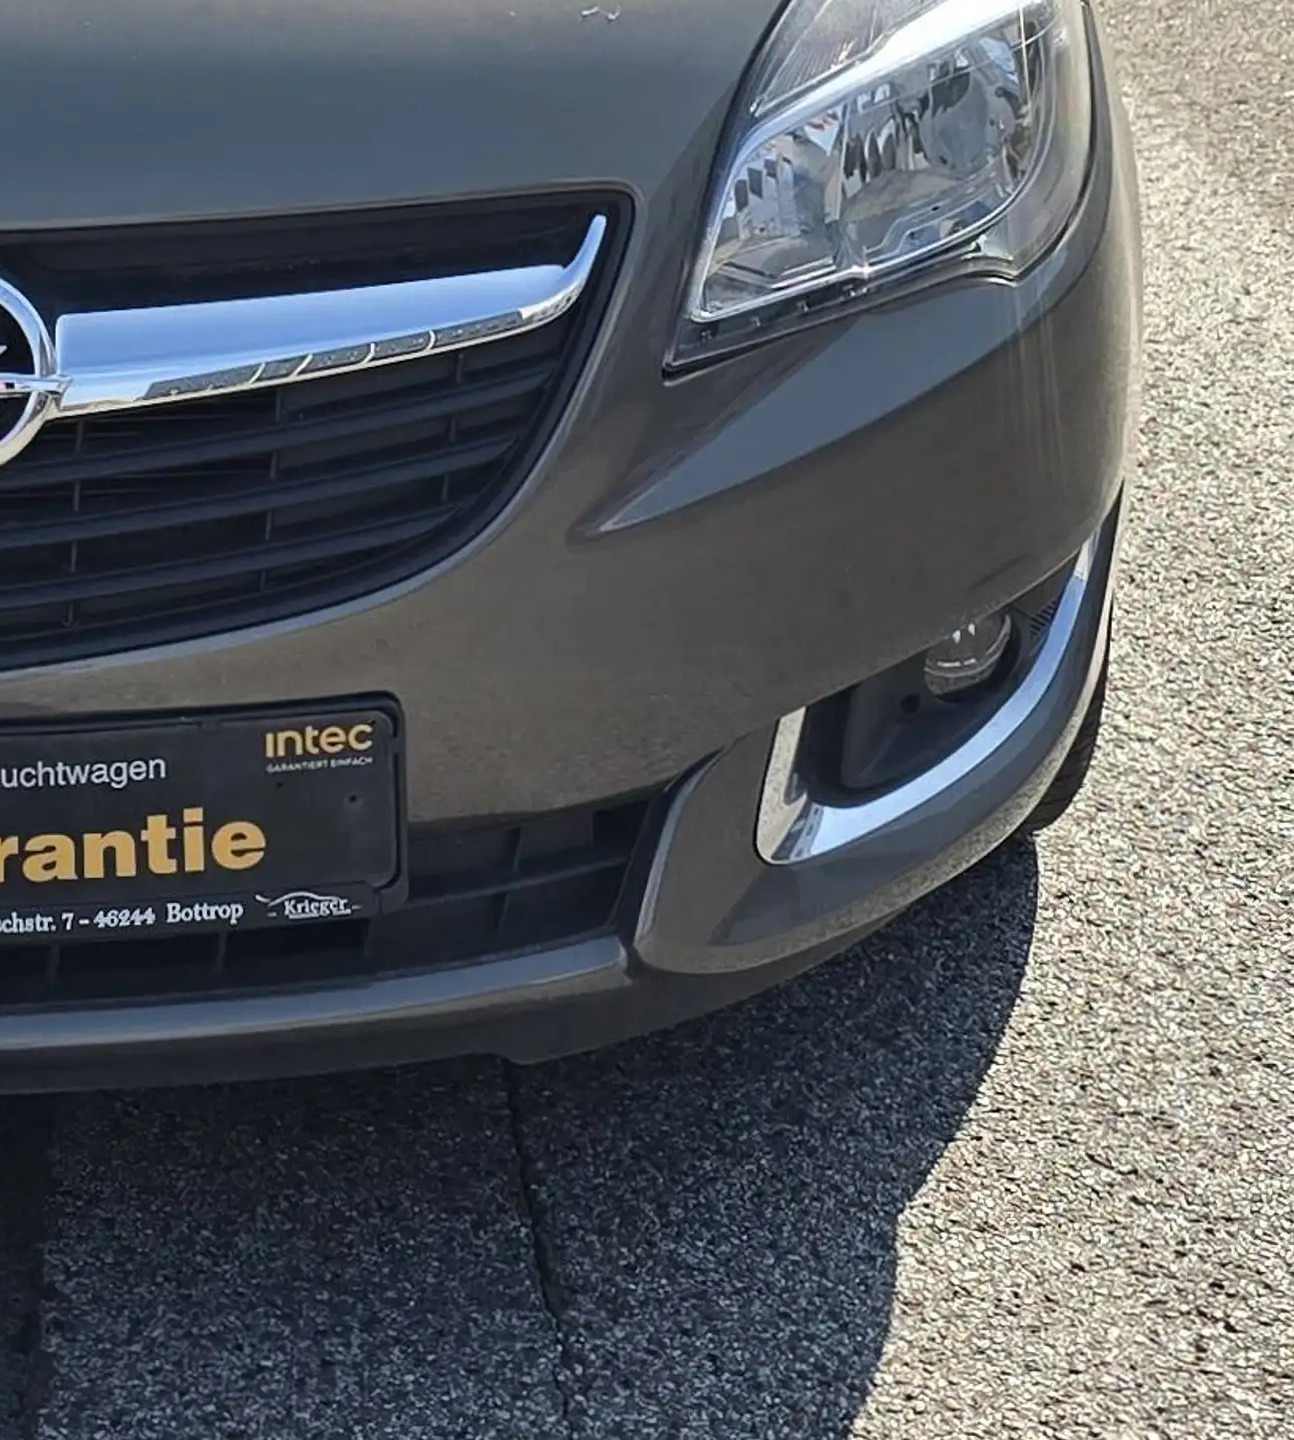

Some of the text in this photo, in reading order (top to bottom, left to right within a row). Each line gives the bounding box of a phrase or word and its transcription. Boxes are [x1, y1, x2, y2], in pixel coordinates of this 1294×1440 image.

[61, 912, 74, 931] 7
[93, 906, 156, 928] 46244
[166, 902, 244, 926] Bottrop
